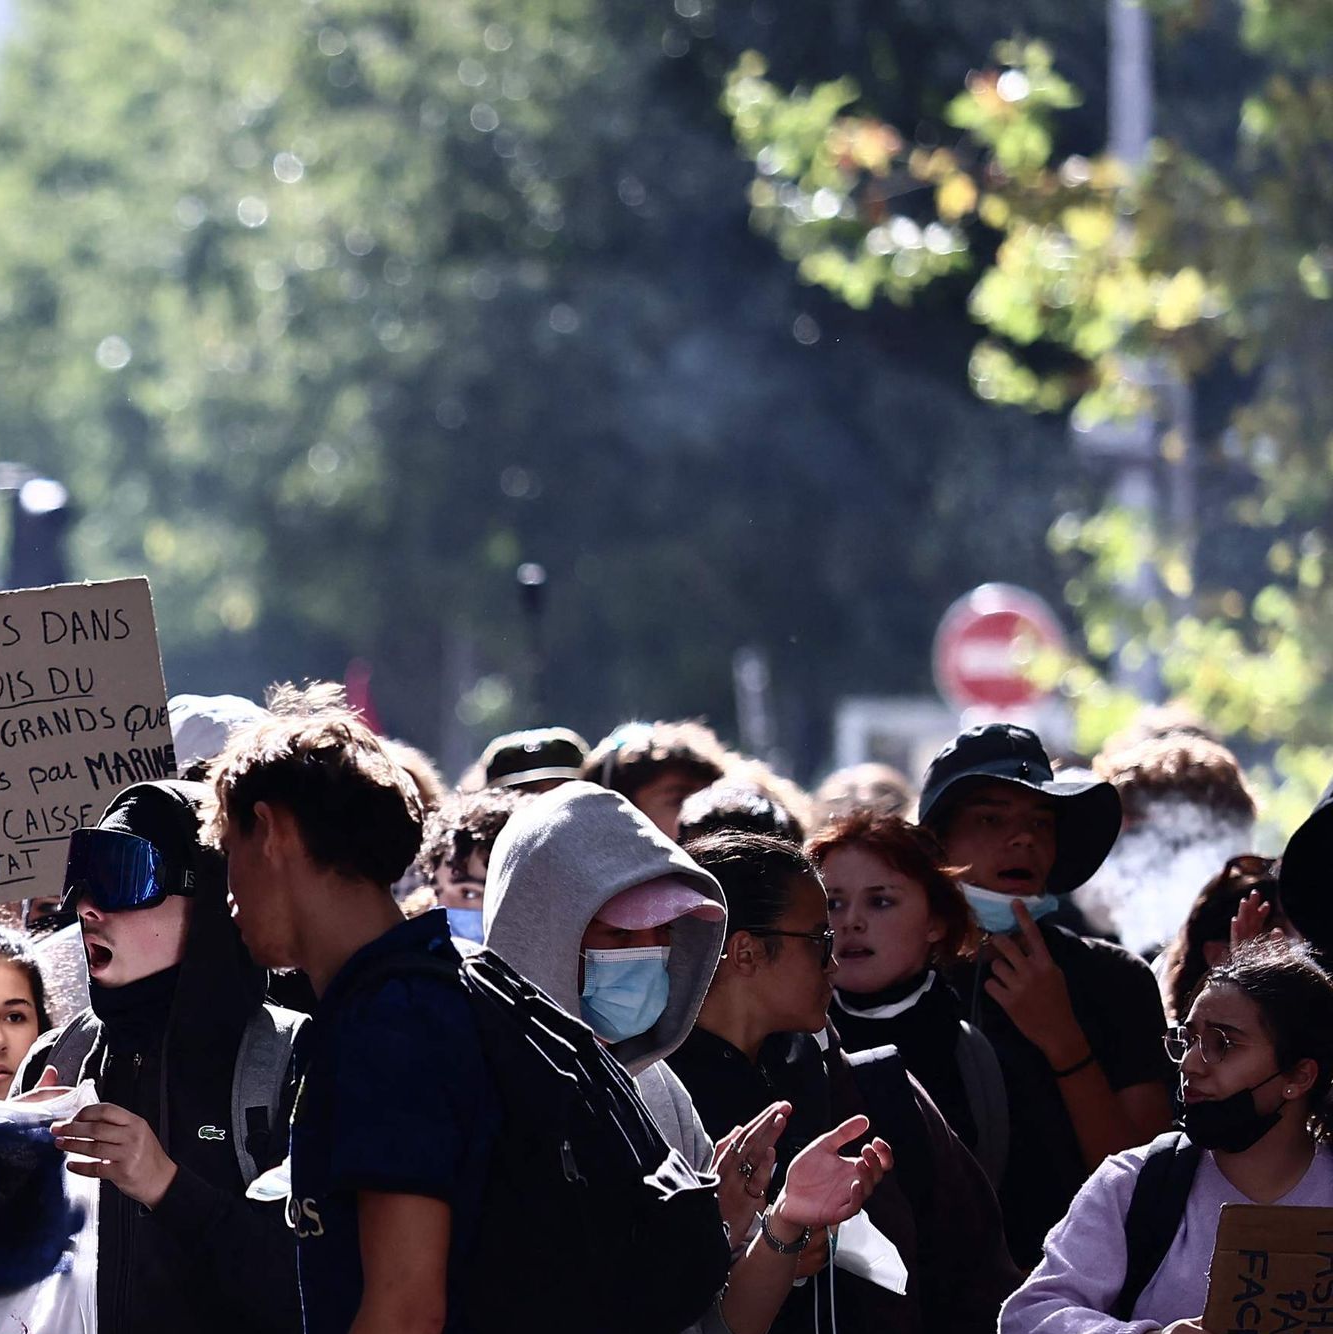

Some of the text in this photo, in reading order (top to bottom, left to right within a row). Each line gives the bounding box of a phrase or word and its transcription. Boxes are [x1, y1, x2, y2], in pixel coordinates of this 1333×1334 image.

[41, 608, 131, 646] DANS
[49, 667, 94, 696] DU
[0, 705, 116, 748] GRANDS
[124, 704, 169, 742] QUE
[29, 760, 78, 795] par
[84, 744, 178, 791] MARINE
[2, 804, 94, 841] CAISSE
